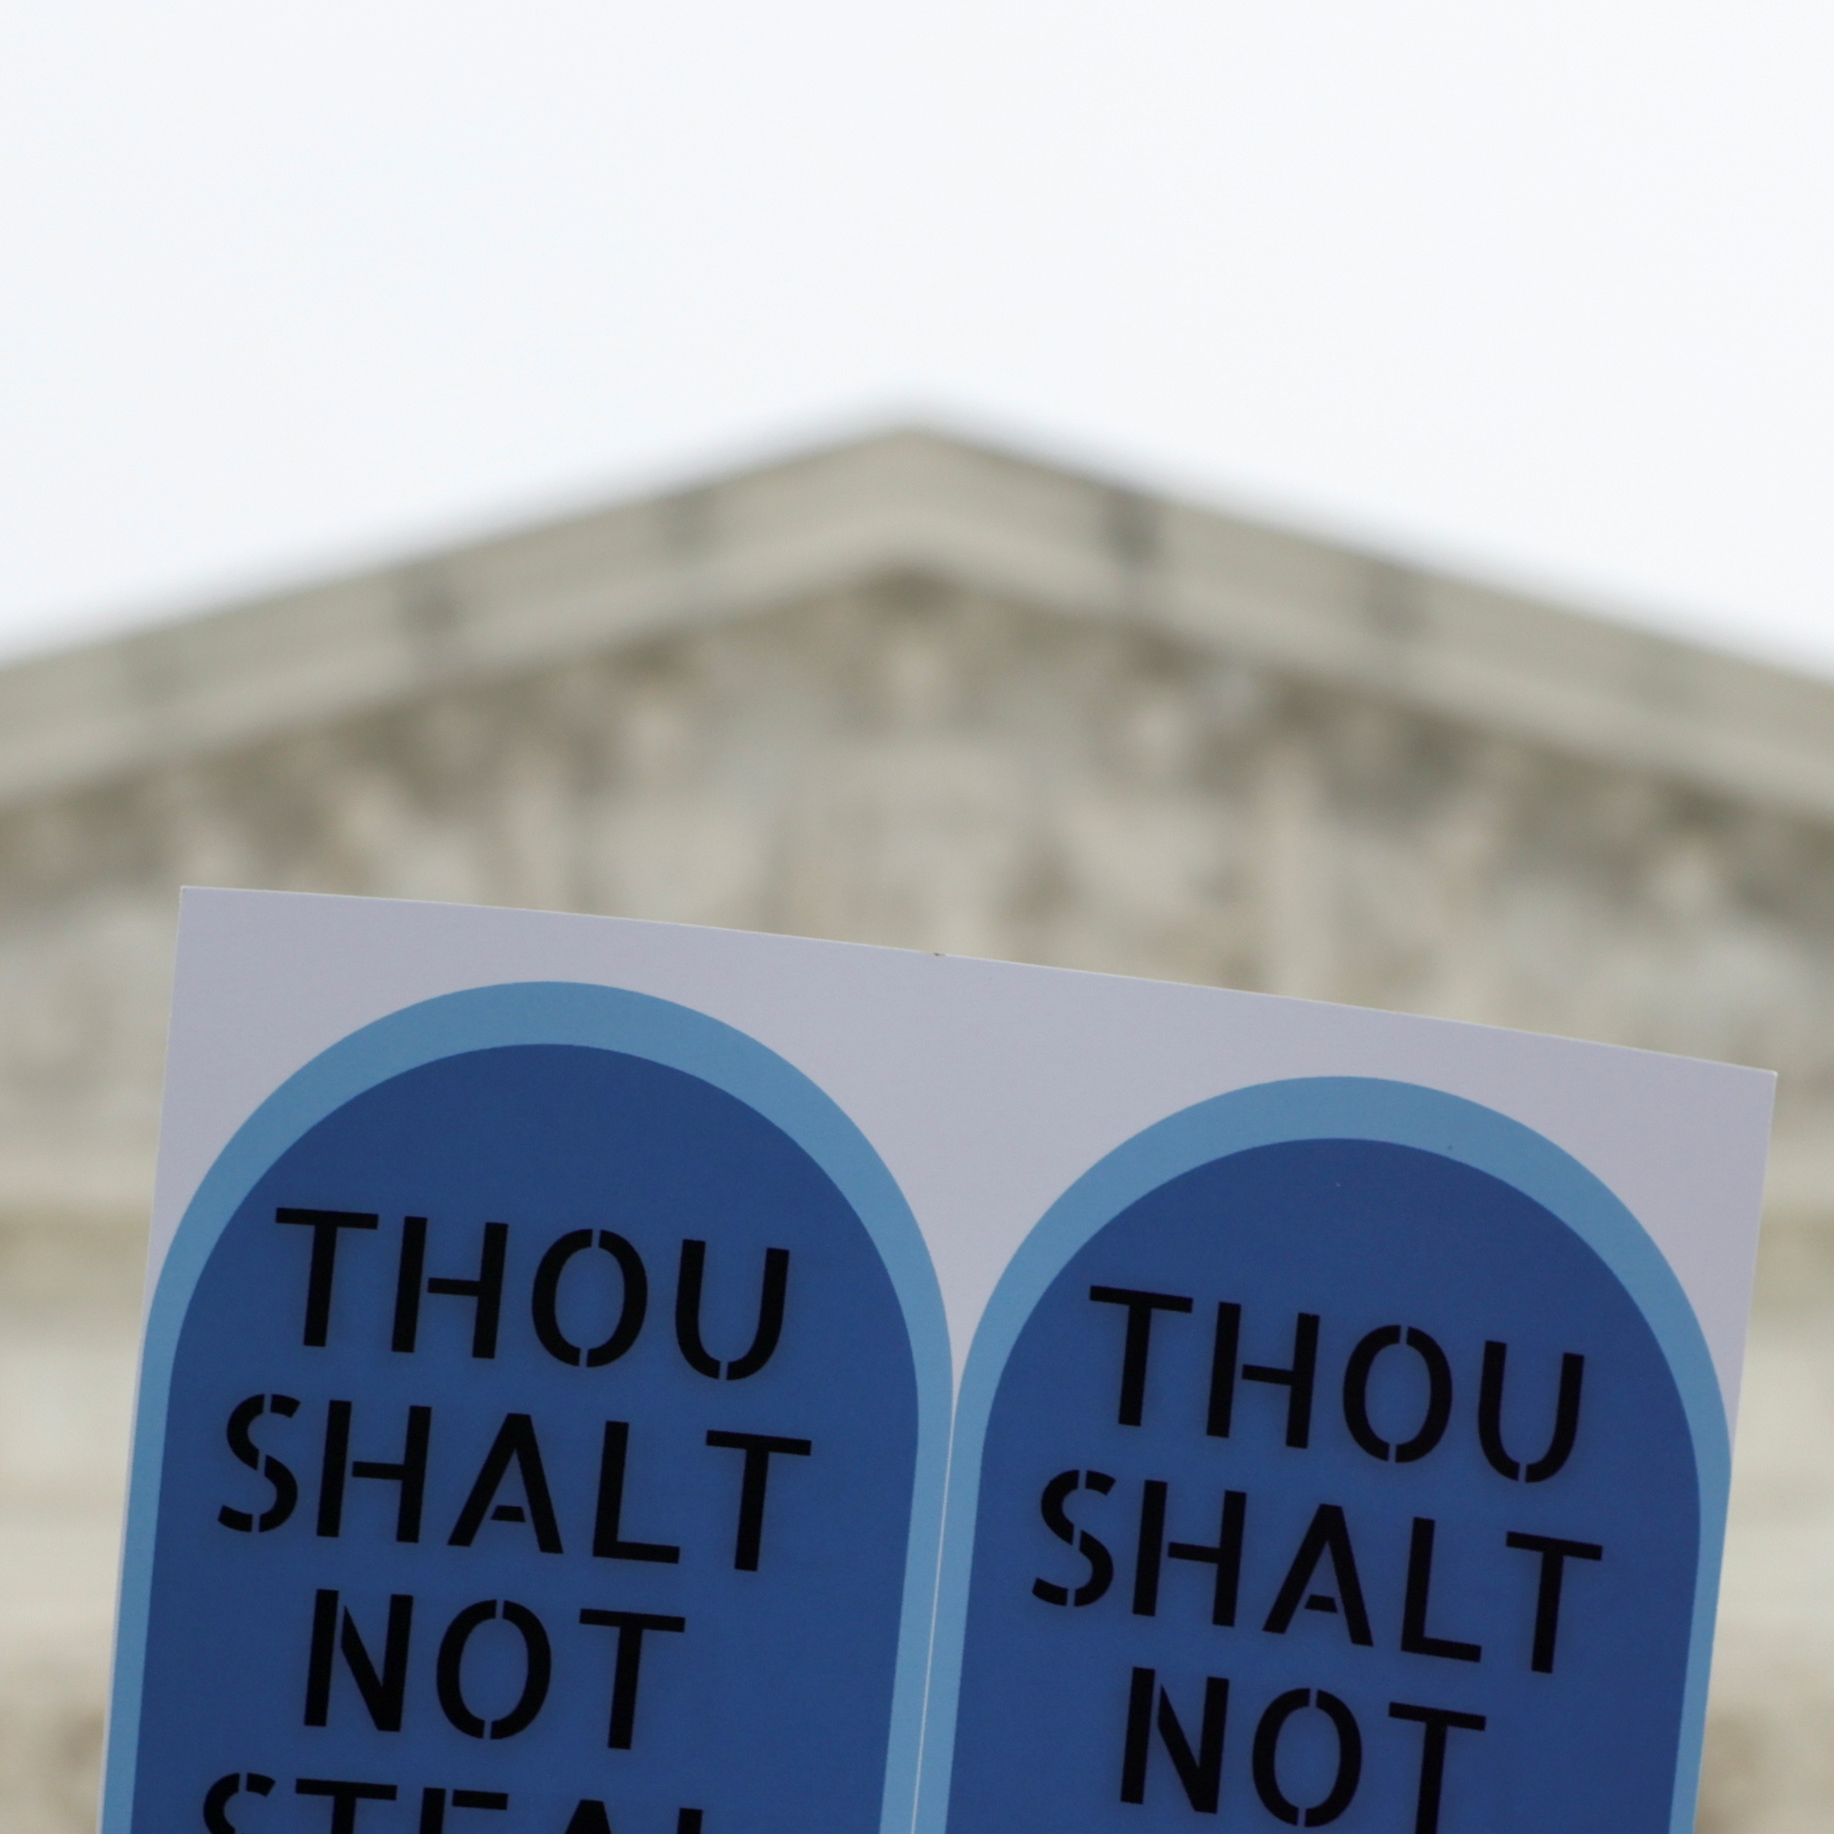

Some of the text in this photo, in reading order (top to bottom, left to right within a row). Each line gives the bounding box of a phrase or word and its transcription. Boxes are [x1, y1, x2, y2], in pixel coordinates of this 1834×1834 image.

[275, 1208, 790, 1381] THOU
[1089, 1286, 1585, 1483] THOU
[218, 1394, 812, 1572] SHALT
[1032, 1470, 1603, 1674] SHALT
[304, 1589, 685, 1750] NOT
